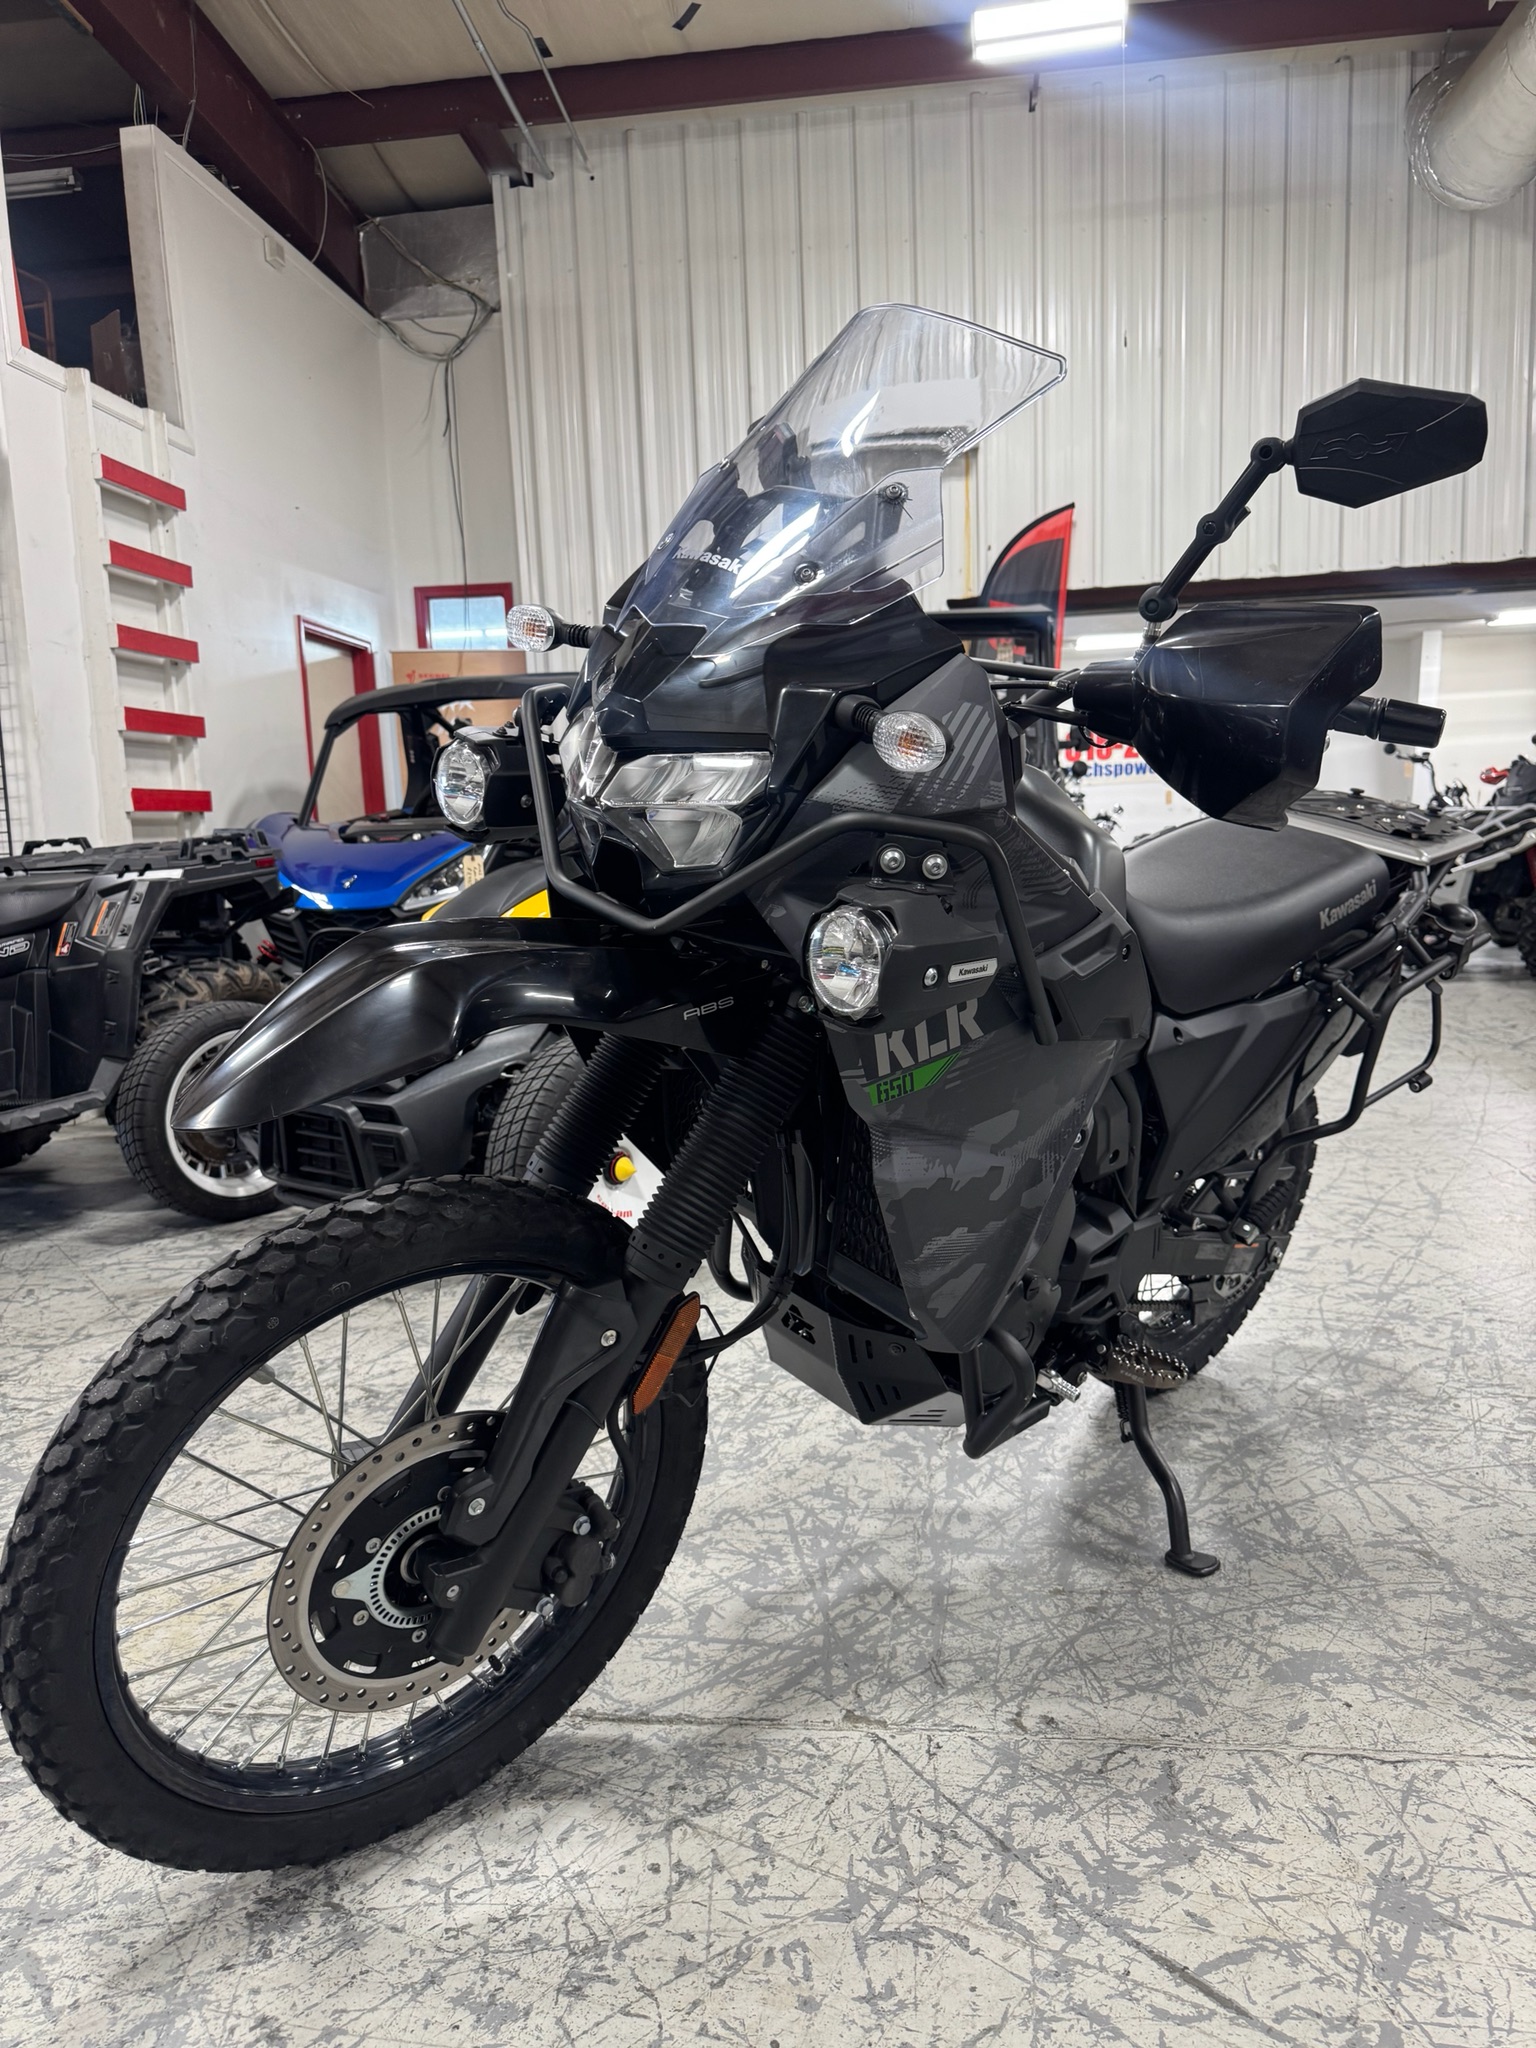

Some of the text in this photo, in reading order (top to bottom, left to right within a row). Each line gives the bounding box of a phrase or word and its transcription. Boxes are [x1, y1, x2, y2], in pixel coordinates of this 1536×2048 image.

[1319, 878, 1377, 930] Kawasaki
[958, 963, 989, 977] Kawasaki
[683, 996, 735, 1021] ABS
[874, 997, 985, 1078] KLR
[876, 1071, 915, 1104] 650
